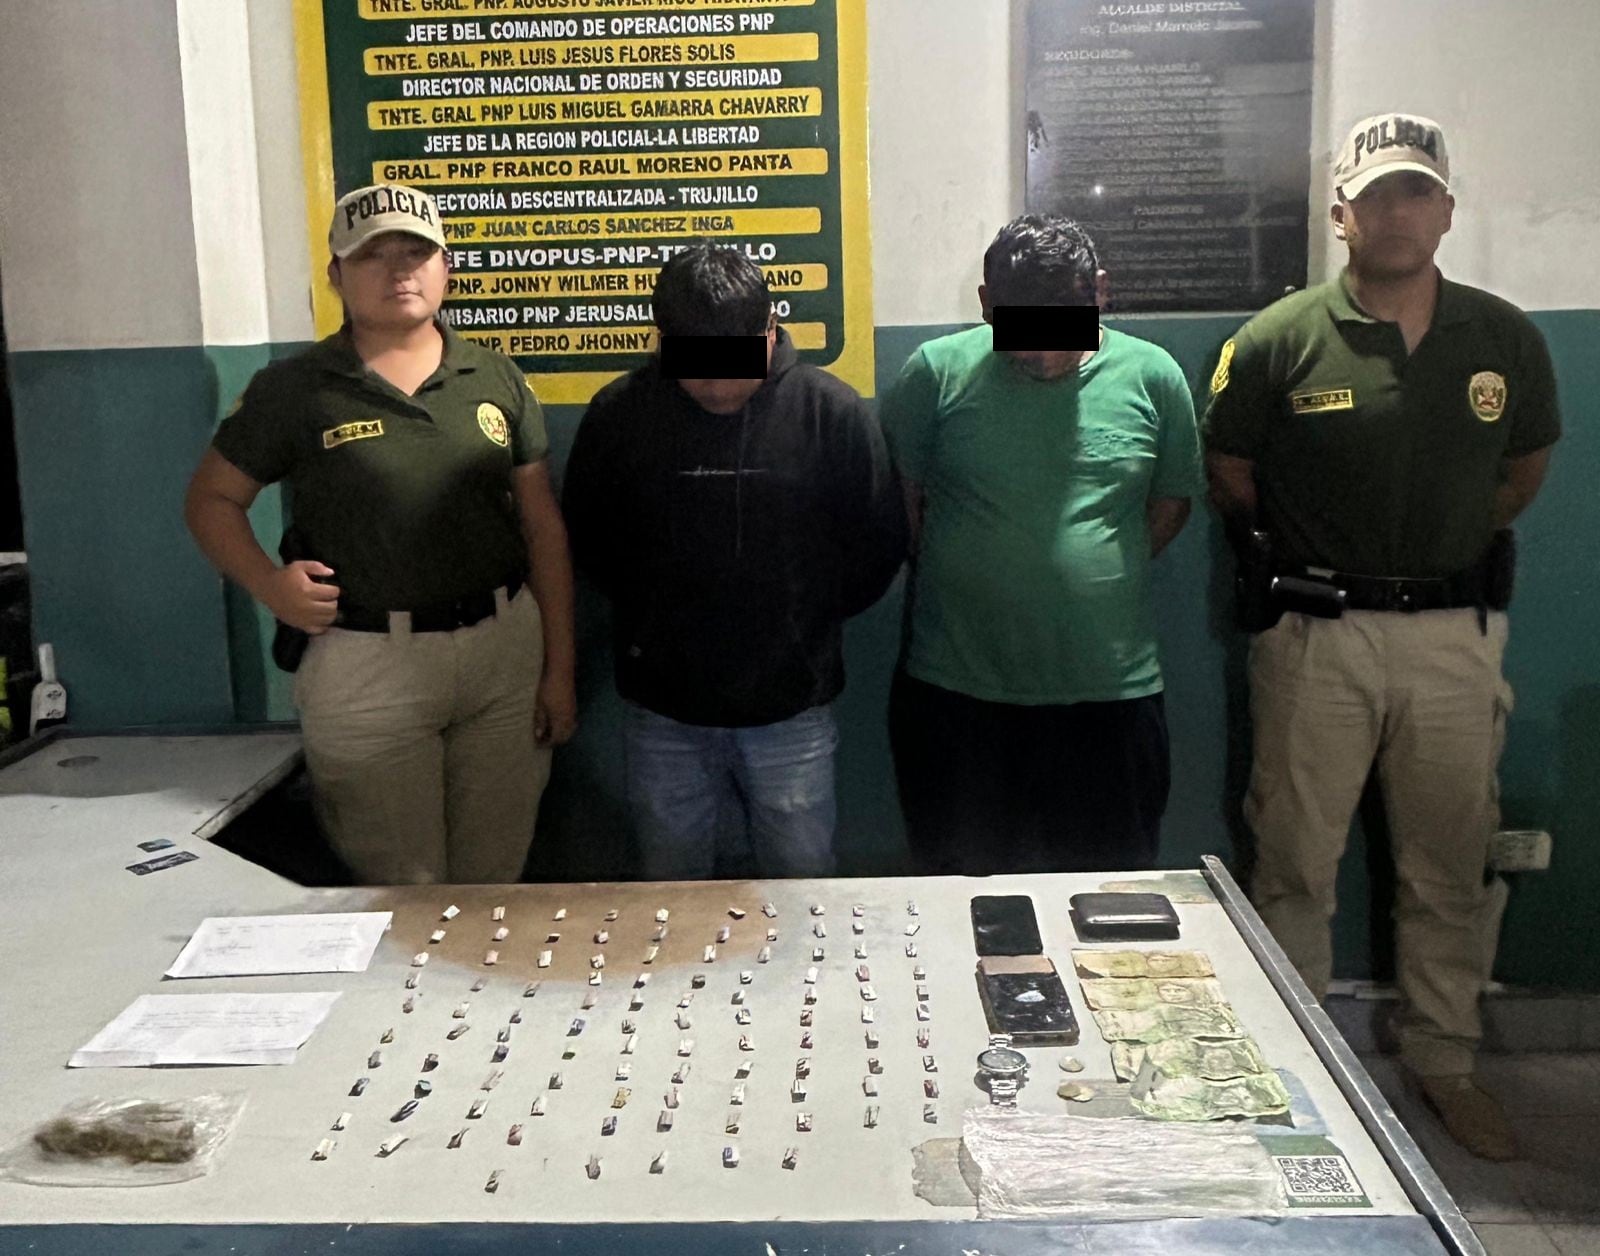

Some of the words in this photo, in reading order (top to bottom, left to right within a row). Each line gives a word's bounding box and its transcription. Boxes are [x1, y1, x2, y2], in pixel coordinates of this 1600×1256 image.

[371, 0, 416, 12] TNTE.
[406, 24, 448, 42] JEFE
[453, 23, 485, 41] DEL
[490, 20, 577, 39] COMANDO
[583, 19, 606, 36] DE
[611, 15, 734, 35] OPERACIONES
[740, 13, 774, 32] PNP
[374, 54, 422, 71] TNTE.
[481, 50, 514, 68] PNP.
[520, 48, 556, 66] LUIS
[562, 46, 614, 65] JESUS
[620, 45, 682, 63] FLORES
[688, 43, 735, 61] SOLIS
[403, 77, 485, 97] DIRECTOR
[490, 75, 575, 95] NACIONAL
[580, 74, 602, 92] DE
[607, 71, 664, 90] ORDEN
[668, 71, 680, 89] Y
[685, 68, 782, 88] SEGURIDAD
[379, 108, 427, 125] TNTE.
[432, 107, 476, 124] GRAL
[481, 105, 514, 122] PNP
[520, 102, 557, 120] LUIS
[562, 100, 626, 118] MIGUEL
[631, 99, 714, 118] GAMARRA
[720, 95, 809, 115] CHAVARRY
[424, 135, 462, 153] JEFE
[466, 134, 487, 151] DE
[492, 133, 513, 151] LA
[517, 131, 577, 150] REGION
[581, 127, 679, 147] POLICIAL-LA
[682, 125, 759, 145] LIBERTAD
[384, 164, 441, 181] GRAL.
[448, 162, 486, 179] PNP
[493, 161, 573, 178] FRANCO
[579, 158, 630, 175] RAUL
[637, 156, 723, 174] MORENO
[729, 154, 792, 171] PANTA
[344, 187, 434, 231] POLICIA
[511, 189, 667, 210] DESCENTRALIZADA
[679, 185, 759, 205] TRUJILLO
[442, 222, 476, 240] PNP
[481, 220, 528, 238] JUAN
[532, 218, 600, 236] CARLOS
[605, 216, 687, 234] SANCHEZ
[448, 279, 485, 295] PNP.
[491, 275, 552, 294] JONNY
[558, 274, 630, 292] WILMER
[435, 307, 518, 326] MISARIO
[523, 306, 560, 324] PNP
[510, 334, 570, 352] PEDRO
[575, 332, 651, 351] JHONNY
